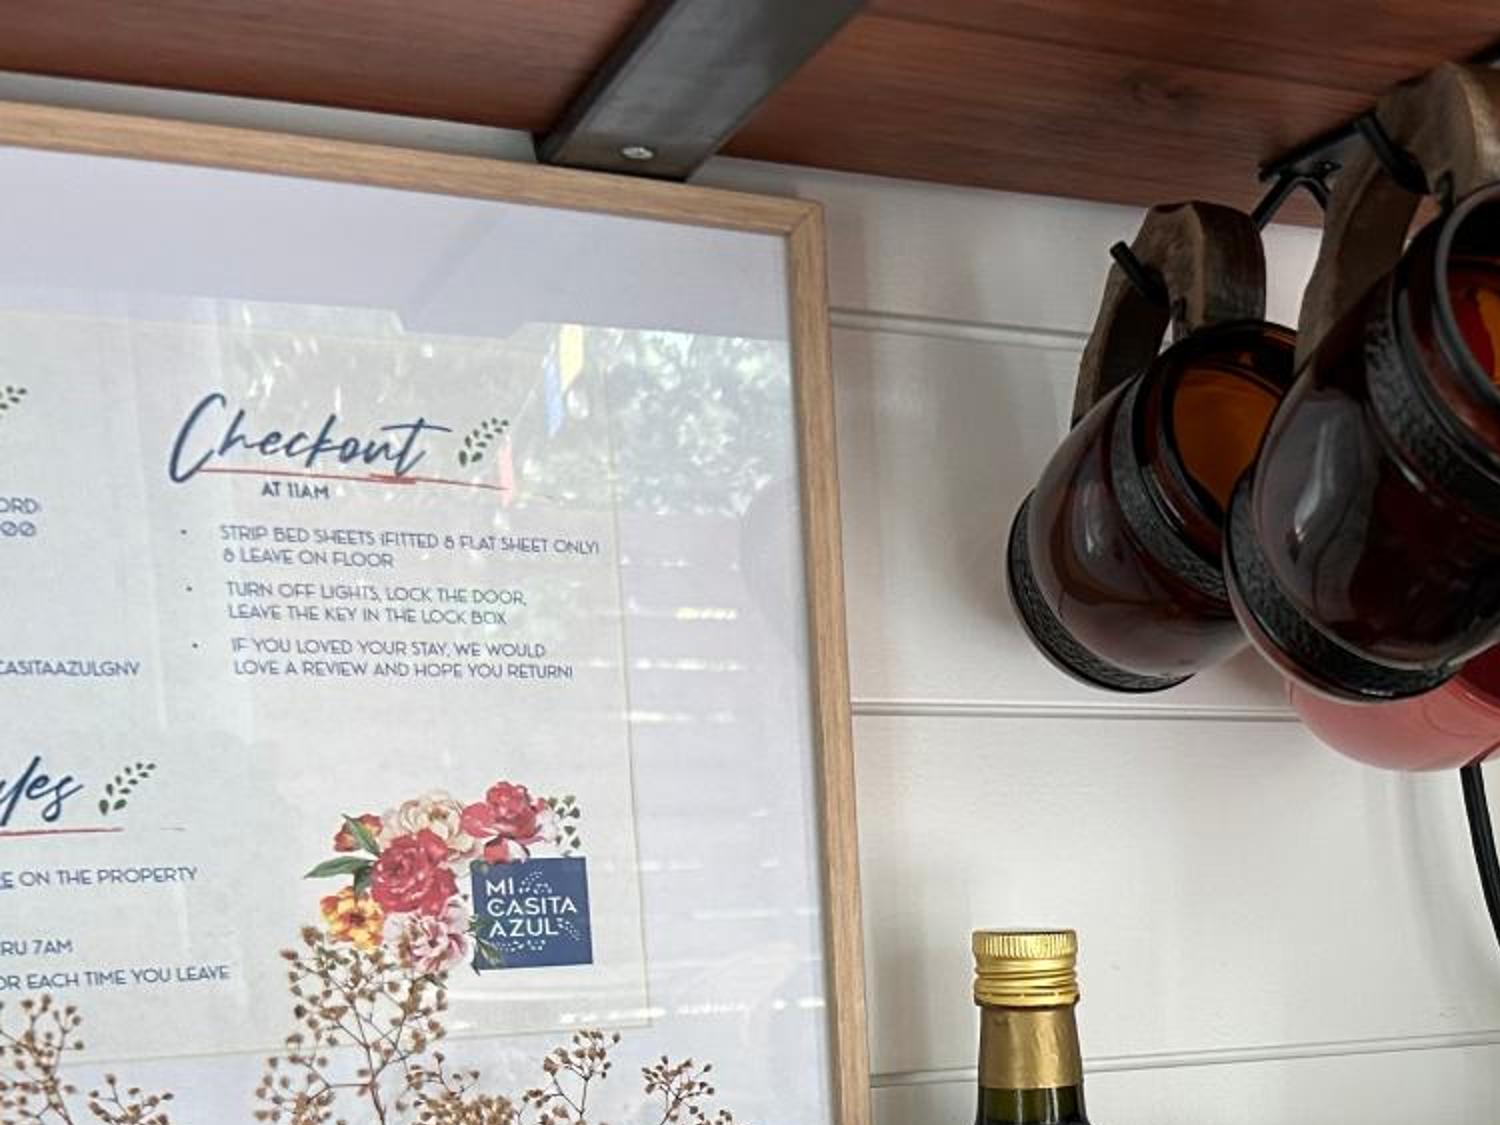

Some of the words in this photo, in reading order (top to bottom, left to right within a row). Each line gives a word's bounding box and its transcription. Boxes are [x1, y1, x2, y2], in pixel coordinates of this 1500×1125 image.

[169, 393, 453, 483] Checkout
[261, 482, 280, 497] AT
[287, 483, 330, 499] 11AM
[221, 525, 267, 541] STRIP
[273, 527, 310, 543] BED
[314, 529, 374, 546] SHEETS
[381, 531, 439, 549] (FITTED
[459, 535, 497, 551] FLAT
[501, 537, 548, 553] SHEET
[241, 549, 294, 565] LEAVE
[300, 551, 327, 565] ON
[333, 552, 394, 567] FLOOR
[227, 581, 273, 597] TURN
[278, 583, 315, 598] OFF
[321, 585, 382, 603] LIGHTS,
[387, 586, 432, 602] LOCK
[437, 588, 467, 603] THE
[472, 589, 528, 606] DOOR,
[229, 605, 281, 619] LEAVE
[287, 605, 319, 621] THE
[325, 608, 357, 622] KEY
[363, 608, 379, 621] IN
[386, 608, 417, 623] THE
[422, 609, 466, 625] LOCK
[472, 612, 508, 625] BOX
[232, 637, 247, 652] IF
[252, 638, 291, 653] YOU
[296, 640, 352, 655] LOVED
[357, 640, 407, 655] YOUR
[453, 643, 481, 657] WE
[485, 643, 546, 658] WOULD
[235, 660, 279, 675] LOVE
[285, 661, 298, 675] A
[303, 661, 368, 677] REVIEW
[373, 662, 409, 677] AND
[415, 664, 462, 678] HOPE
[467, 664, 503, 678] YOU
[507, 664, 573, 679] RETURN!
[19, 871, 50, 887] ON
[56, 869, 91, 885] THE
[98, 866, 197, 884] PROPERTY
[486, 877, 514, 896] MI
[487, 896, 577, 917] CASITA
[489, 917, 559, 938] AZUL
[32, 939, 73, 955] 7AM
[27, 972, 79, 989] EACH
[84, 969, 127, 986] TIME
[131, 967, 171, 984] YOU
[176, 965, 230, 983] LEAVE
